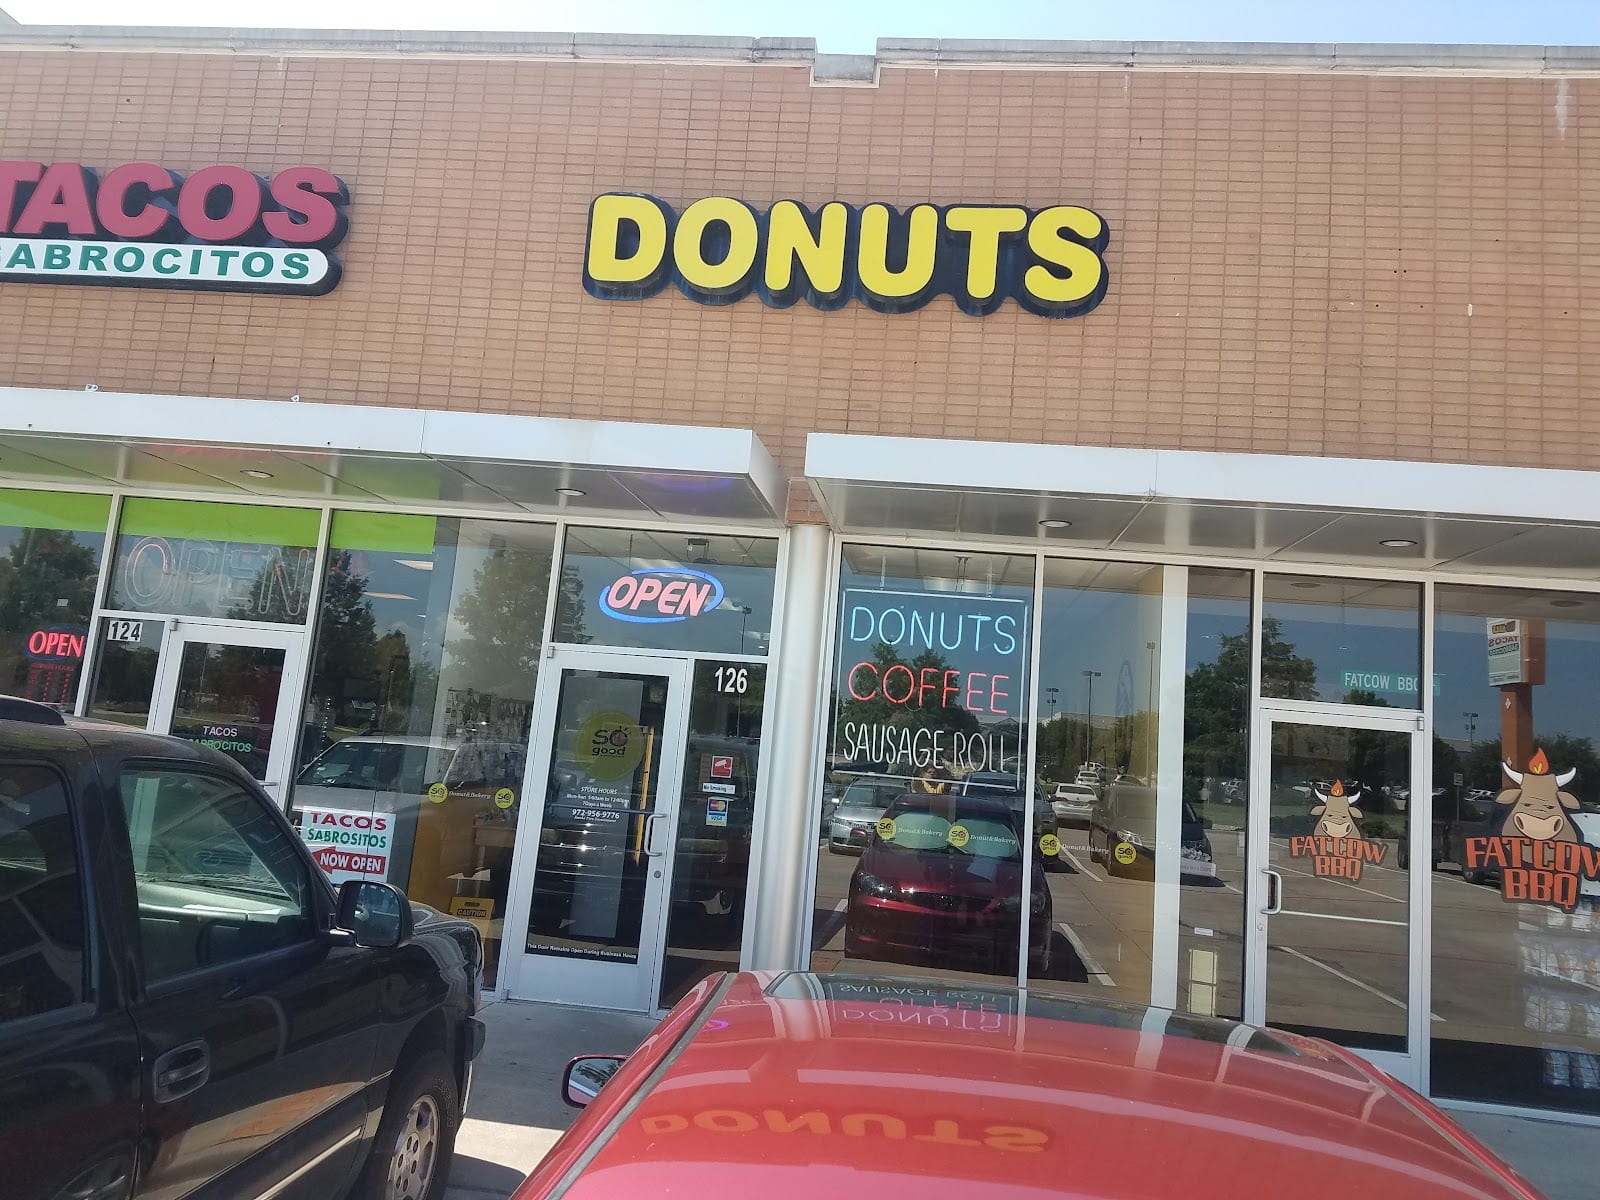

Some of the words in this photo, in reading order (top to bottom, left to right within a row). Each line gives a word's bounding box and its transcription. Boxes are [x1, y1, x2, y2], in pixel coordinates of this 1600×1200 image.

[0, 161, 341, 244] TACOS
[0, 243, 310, 280] ABROCITOS
[585, 193, 1105, 305] DONUTS
[608, 576, 711, 617] OPEN
[28, 630, 85, 658] OPEN
[111, 621, 141, 641] 124
[850, 606, 1016, 655] DONUTS
[715, 667, 748, 694] 126
[848, 662, 1009, 714] COFFEE
[1345, 672, 1390, 689] FATCOW
[203, 725, 238, 737] TACOS
[592, 747, 626, 757] good
[843, 722, 945, 769] SAUSAGE
[953, 731, 1010, 773] ROLL
[311, 812, 387, 831] TACOS
[307, 828, 387, 849] SABROSITOS
[1291, 836, 1387, 864] FATCOW
[320, 852, 349, 869] NOW
[351, 856, 381, 872] OPEN
[1315, 855, 1361, 882] BBQ
[1504, 868, 1578, 910] BBQ
[457, 909, 486, 917] CAUTION
